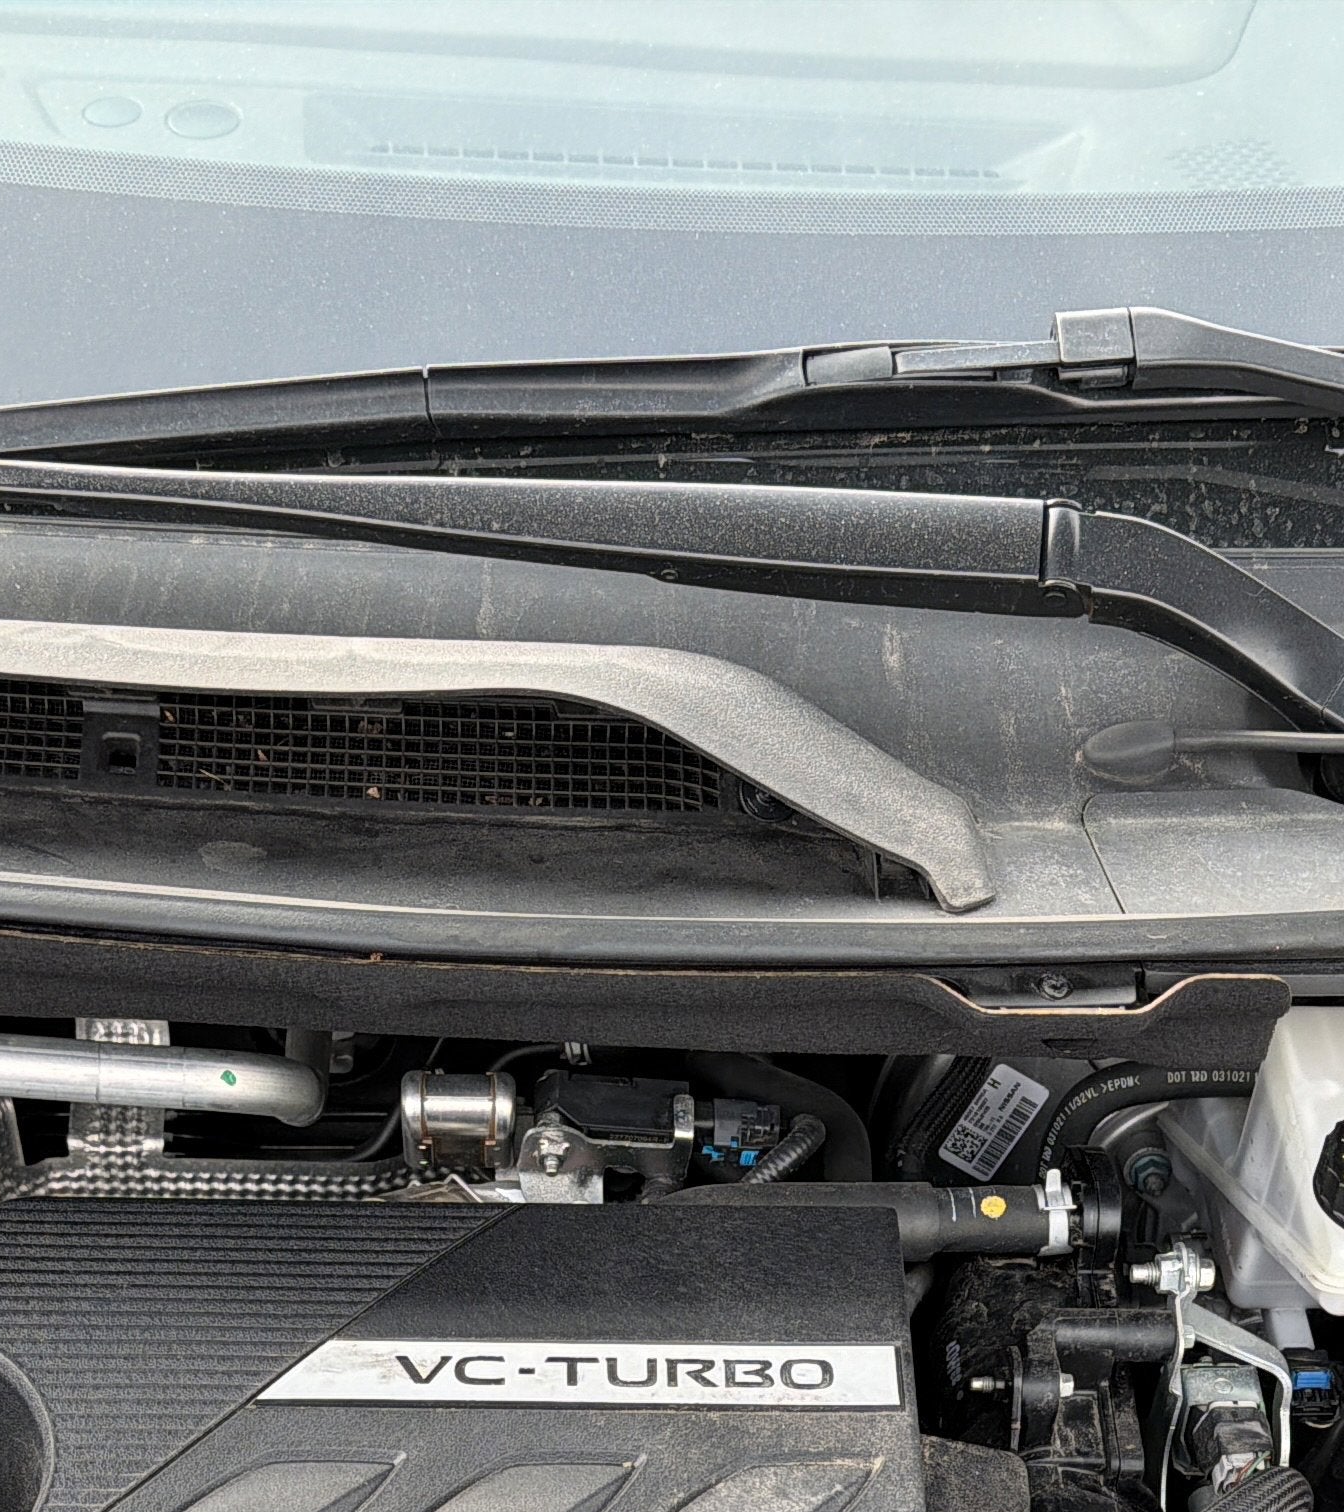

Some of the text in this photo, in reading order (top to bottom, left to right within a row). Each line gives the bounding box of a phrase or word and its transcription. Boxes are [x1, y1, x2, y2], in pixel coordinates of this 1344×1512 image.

[987, 1077, 1002, 1090] H
[1167, 1071, 1187, 1084] DOT
[1211, 1070, 1251, 1083] 031021
[394, 1354, 835, 1390] VC-TURBO
